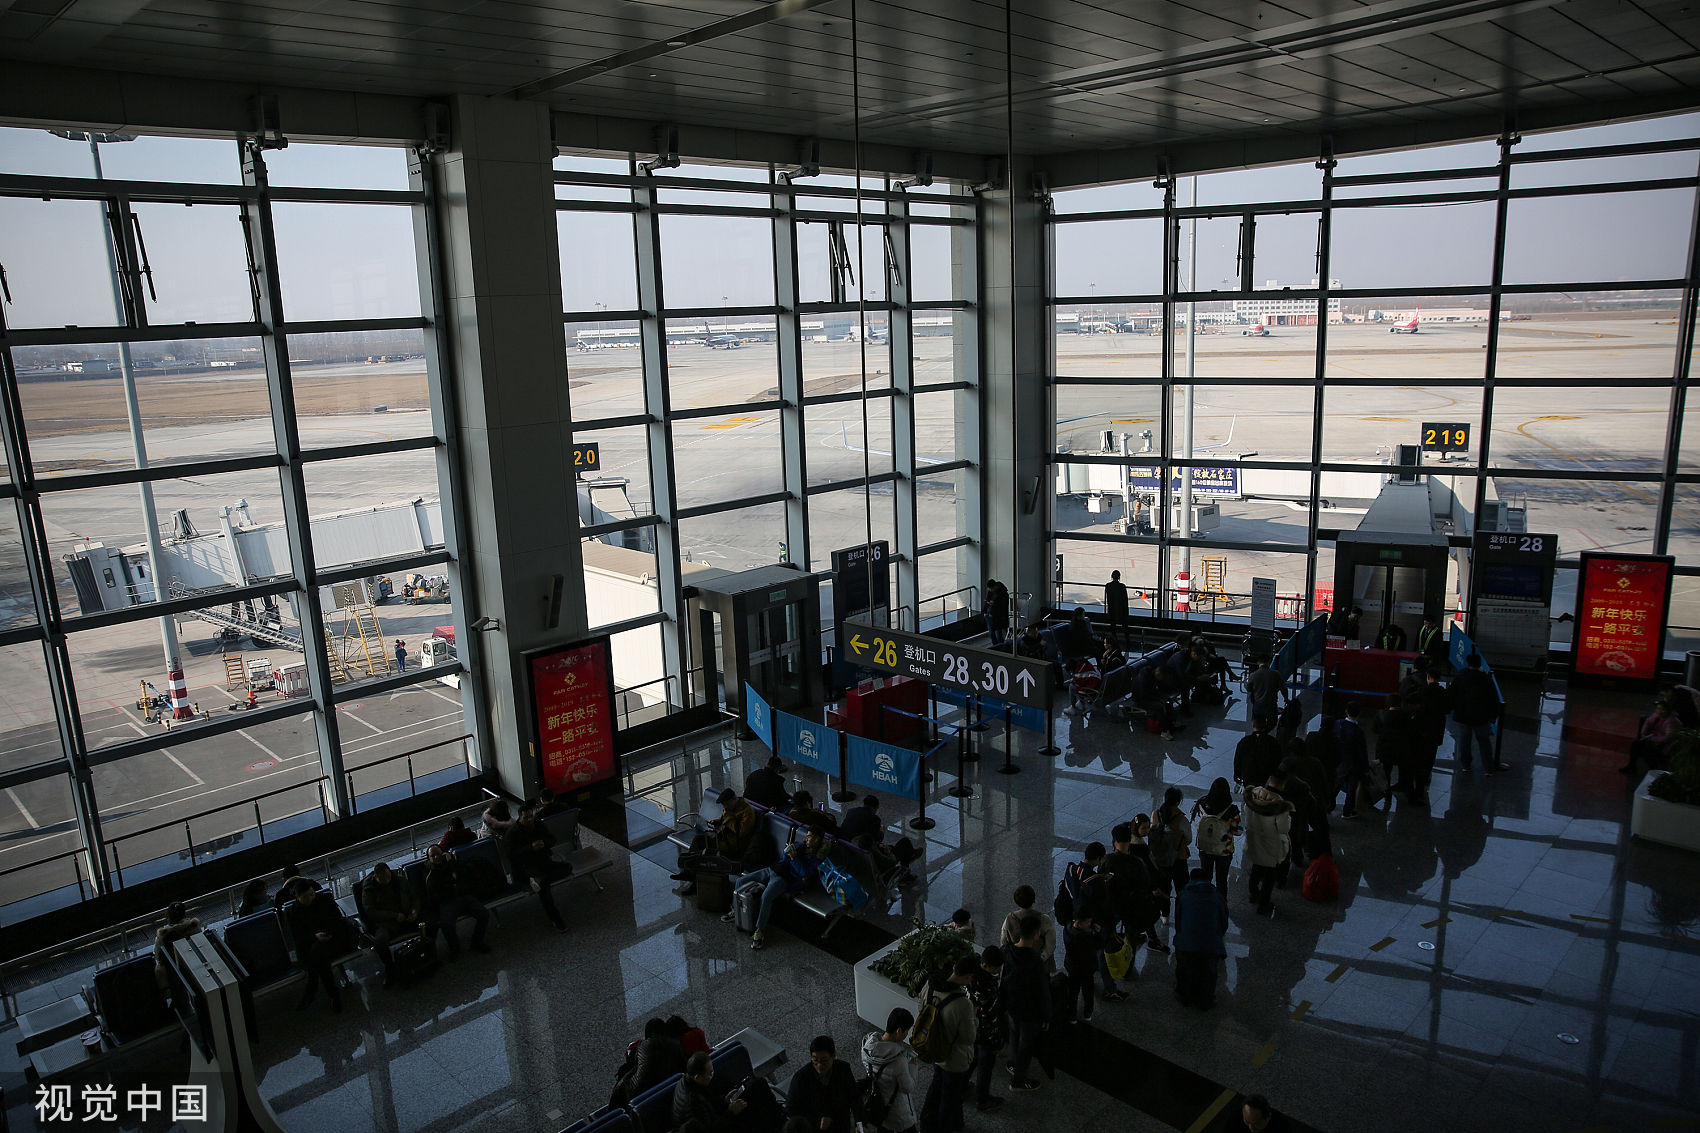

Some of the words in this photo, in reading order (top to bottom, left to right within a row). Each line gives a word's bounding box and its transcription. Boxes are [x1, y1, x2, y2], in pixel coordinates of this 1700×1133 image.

[1425, 429, 1466, 446] 219
[573, 449, 596, 465] 20
[1489, 535, 1517, 545] 登机口
[1519, 536, 1543, 552] 28
[1591, 607, 1648, 622] 新年快乐
[1589, 622, 1646, 636] 一路平安
[873, 637, 898, 667] 26
[904, 644, 937, 665] 登机口
[909, 664, 931, 677] Gates
[547, 703, 599, 730] 新年快乐
[548, 722, 600, 745] 一路平安
[797, 745, 819, 760] HBAH
[872, 769, 898, 785] HBAH
